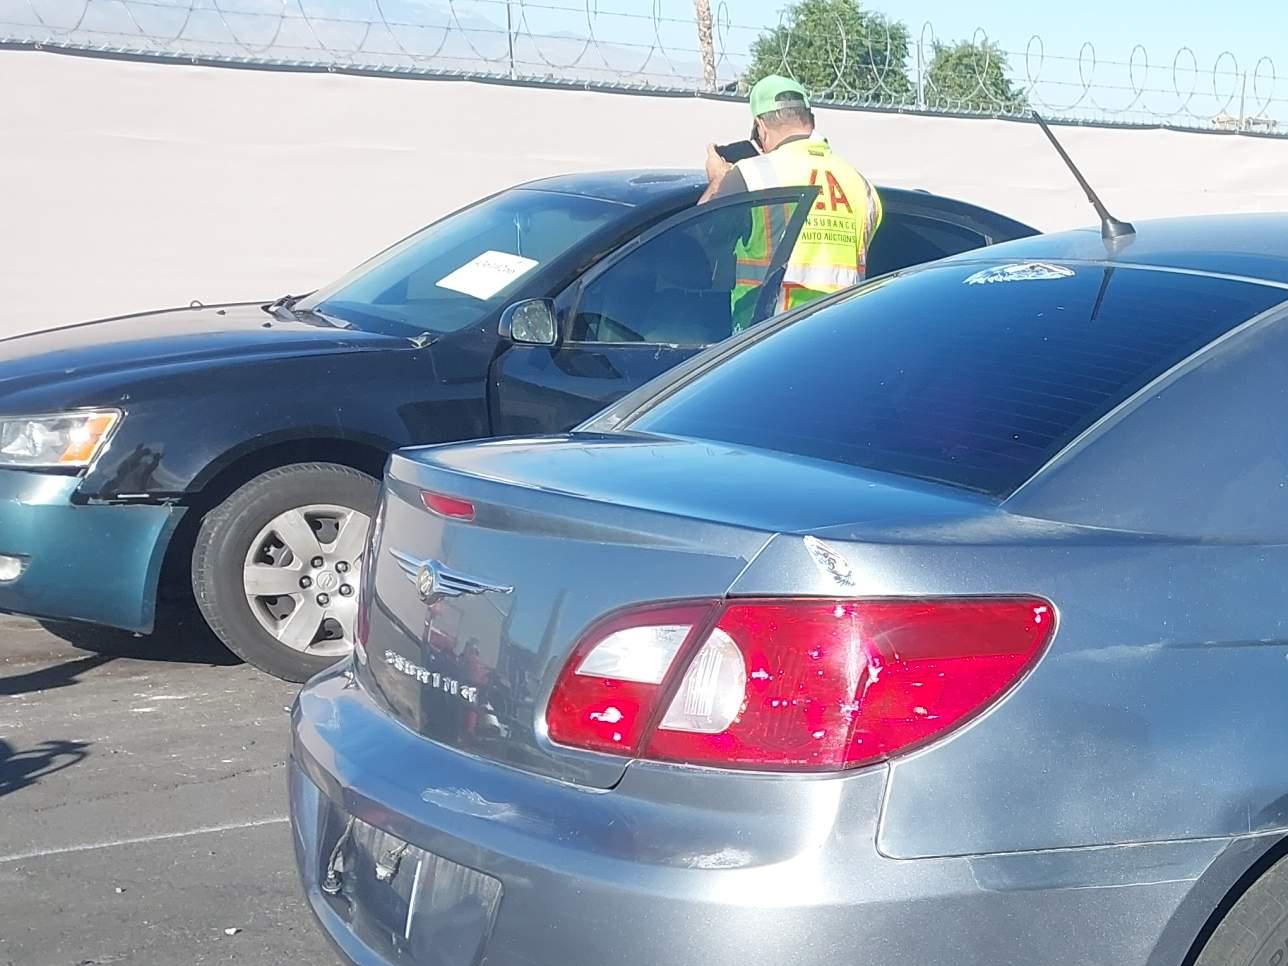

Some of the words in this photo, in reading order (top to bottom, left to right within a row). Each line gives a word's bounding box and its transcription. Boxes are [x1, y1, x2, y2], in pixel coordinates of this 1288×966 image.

[804, 217, 856, 230] NSURANCE
[801, 231, 822, 240] AUTO
[823, 233, 857, 244] AUCTIONS
